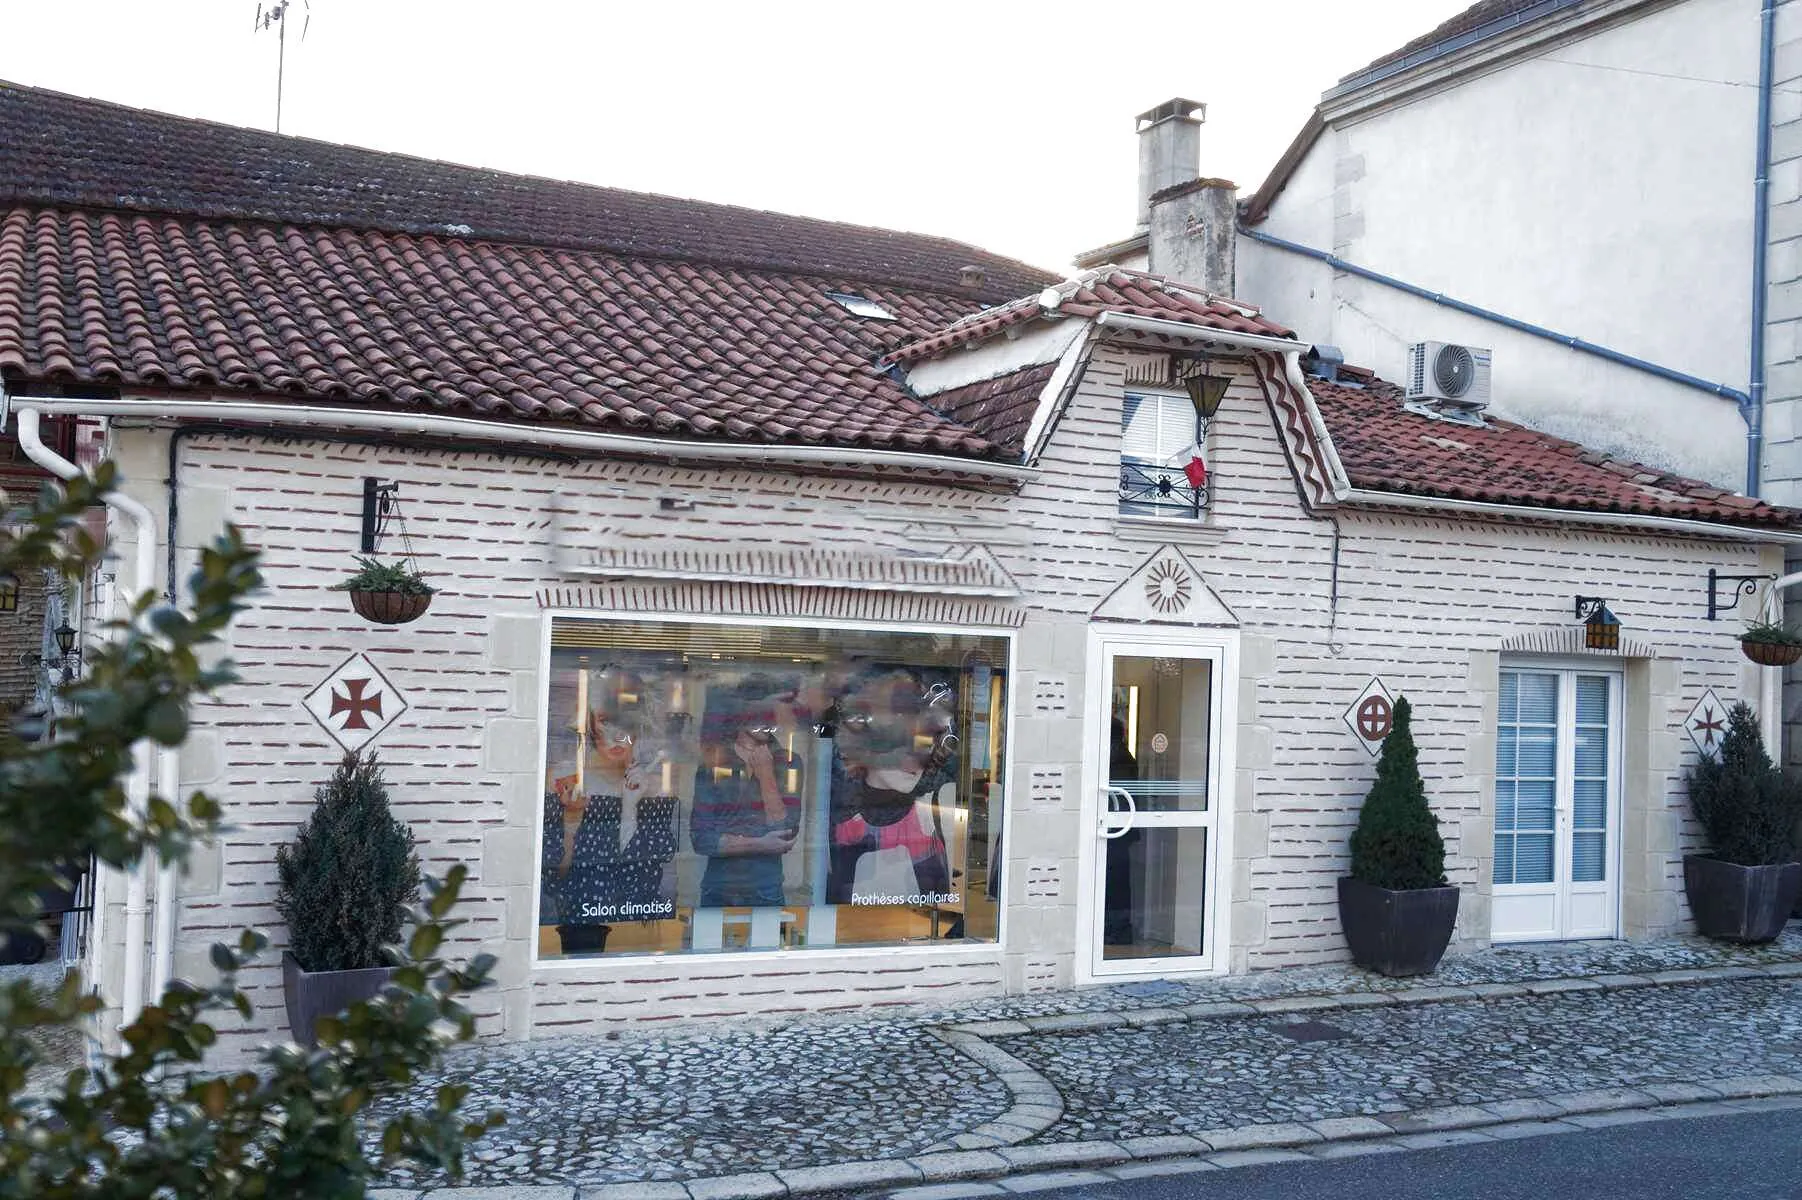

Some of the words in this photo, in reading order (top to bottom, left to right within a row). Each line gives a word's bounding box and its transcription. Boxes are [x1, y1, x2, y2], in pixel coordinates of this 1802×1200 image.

[851, 892, 904, 906] Prothèses
[907, 890, 960, 907] capillaires
[582, 902, 616, 917] Salon
[620, 899, 673, 915] climatisé
